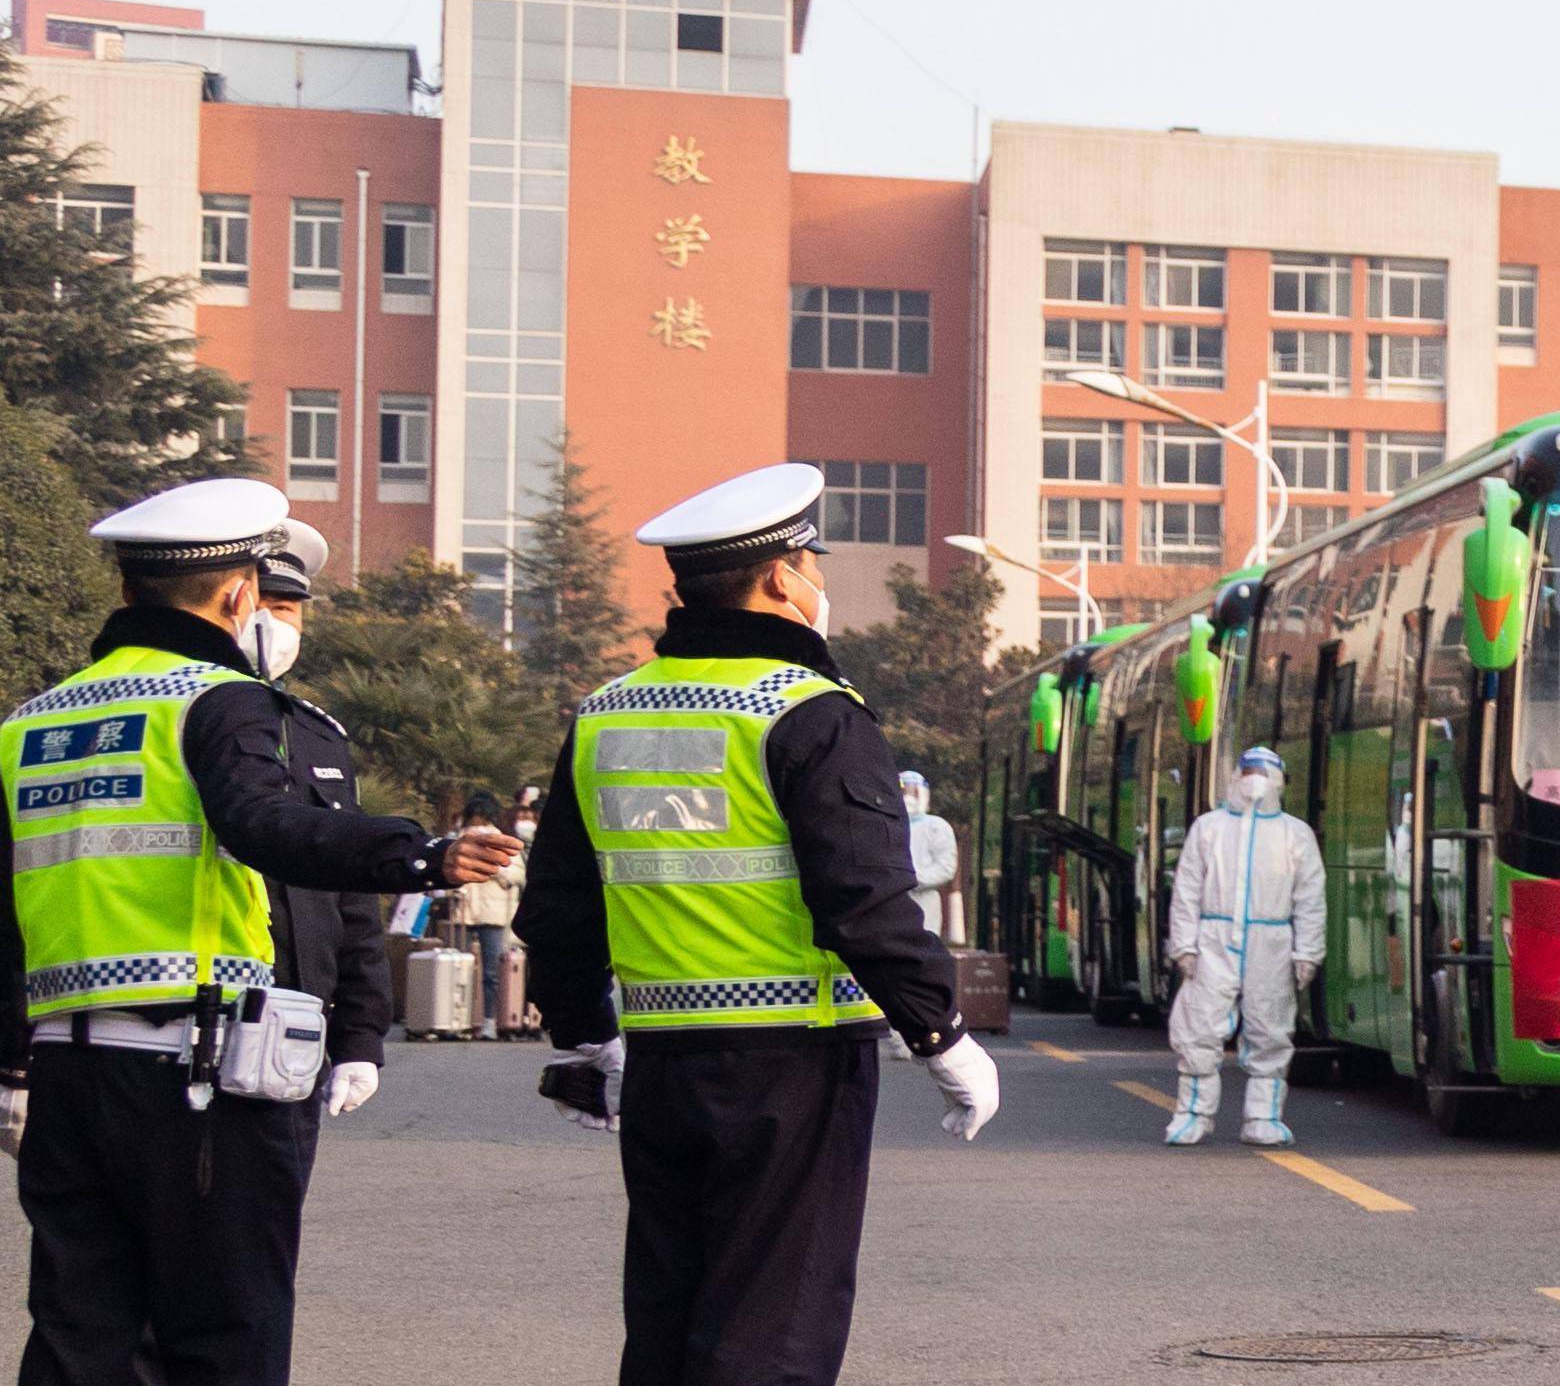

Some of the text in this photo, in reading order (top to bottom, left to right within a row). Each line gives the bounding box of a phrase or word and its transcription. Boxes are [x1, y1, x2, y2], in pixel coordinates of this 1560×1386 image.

[649, 134, 713, 351] 教学楼
[42, 719, 127, 761] 警察
[28, 778, 128, 806] POLICE
[146, 832, 201, 847] POLICE
[633, 860, 685, 875] POLICE
